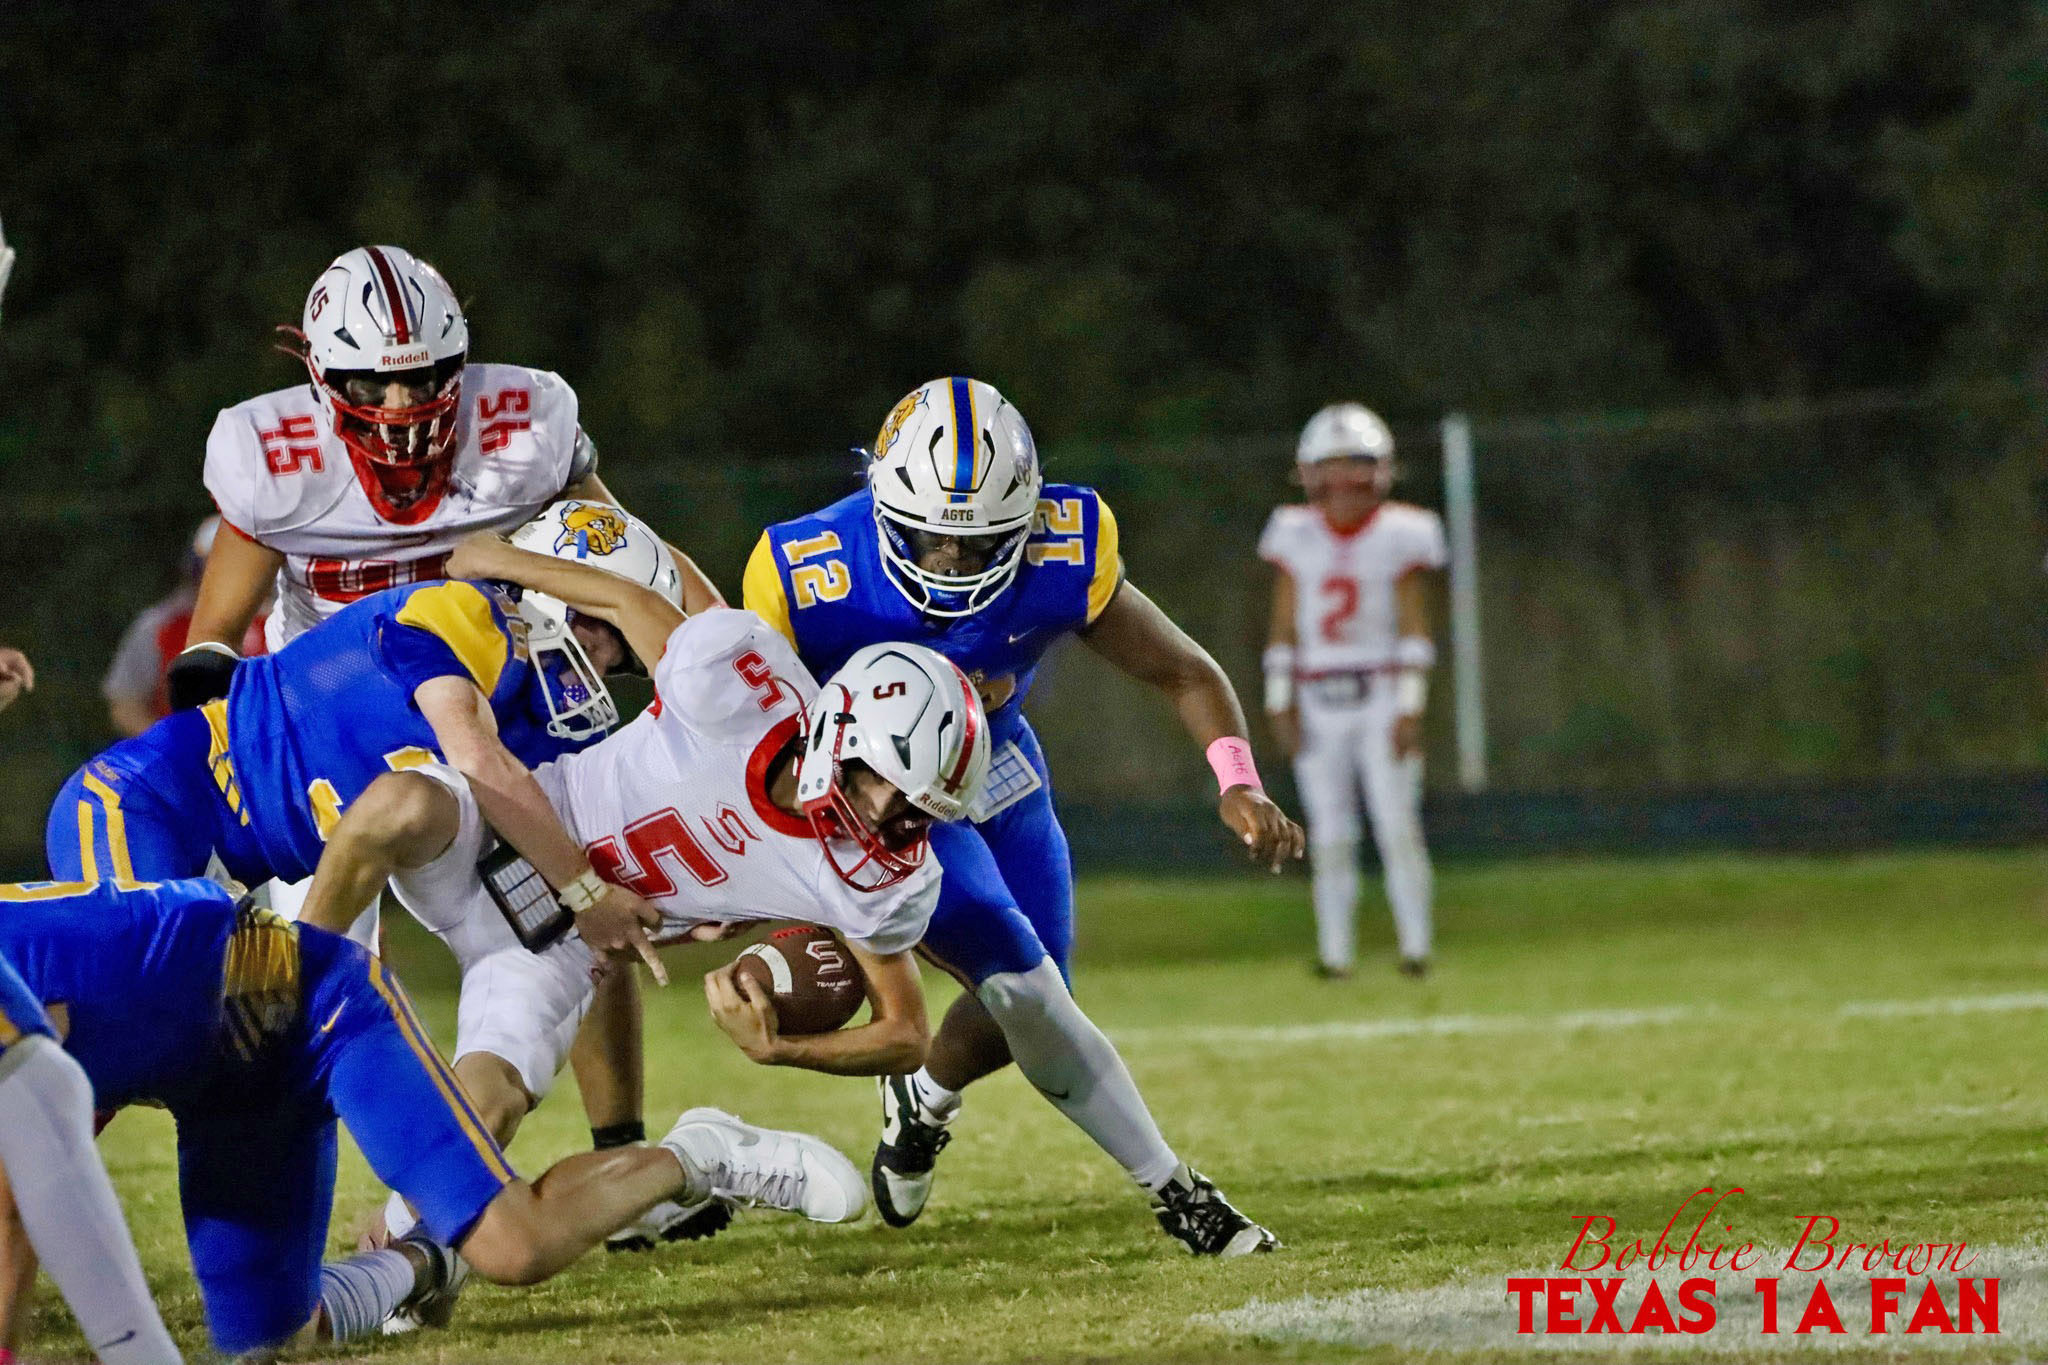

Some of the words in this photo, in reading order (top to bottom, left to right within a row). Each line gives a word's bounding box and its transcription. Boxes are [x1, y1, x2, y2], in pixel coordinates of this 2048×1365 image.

[310, 286, 329, 322] 45
[381, 351, 429, 366] Riddell
[259, 414, 325, 477] 45
[476, 388, 531, 456] 45
[941, 508, 975, 521] AGTG
[1026, 498, 1086, 566] 12
[781, 530, 852, 610] 12
[1320, 575, 1360, 645] 2
[733, 650, 785, 712] 5
[873, 682, 906, 700] 5
[919, 792, 958, 819] Riddell
[586, 806, 729, 900] 5
